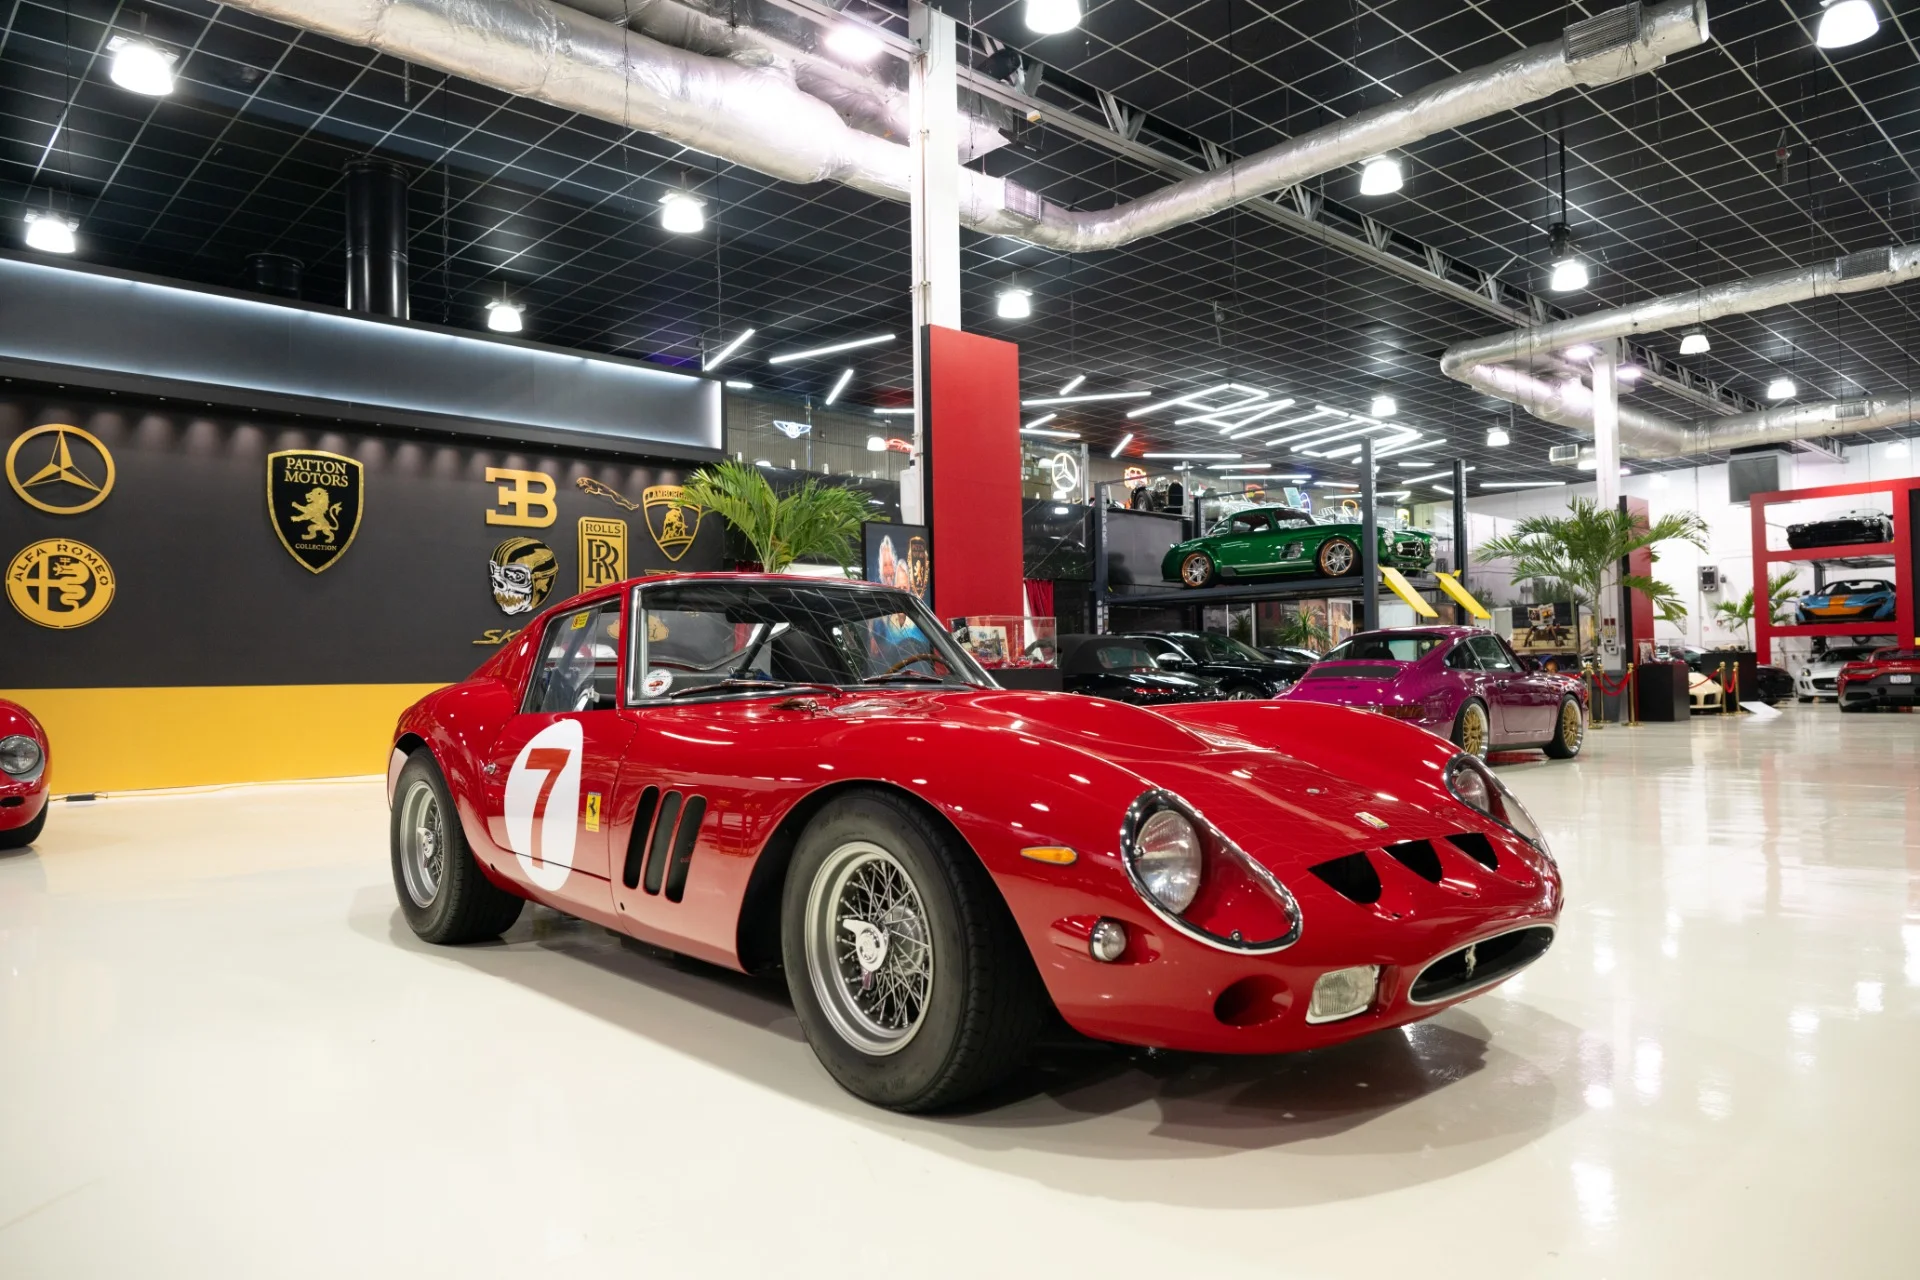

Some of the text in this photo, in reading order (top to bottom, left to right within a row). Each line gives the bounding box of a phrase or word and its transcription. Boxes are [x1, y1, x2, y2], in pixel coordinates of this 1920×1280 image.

[285, 457, 347, 475] PATTON
[283, 470, 349, 488] MOTORS
[585, 523, 621, 534] ROLLS
[295, 543, 337, 551] COLLECTION
[14, 543, 110, 587] ALFA ROMEO
[587, 538, 620, 584] RR
[525, 747, 572, 870] 7
